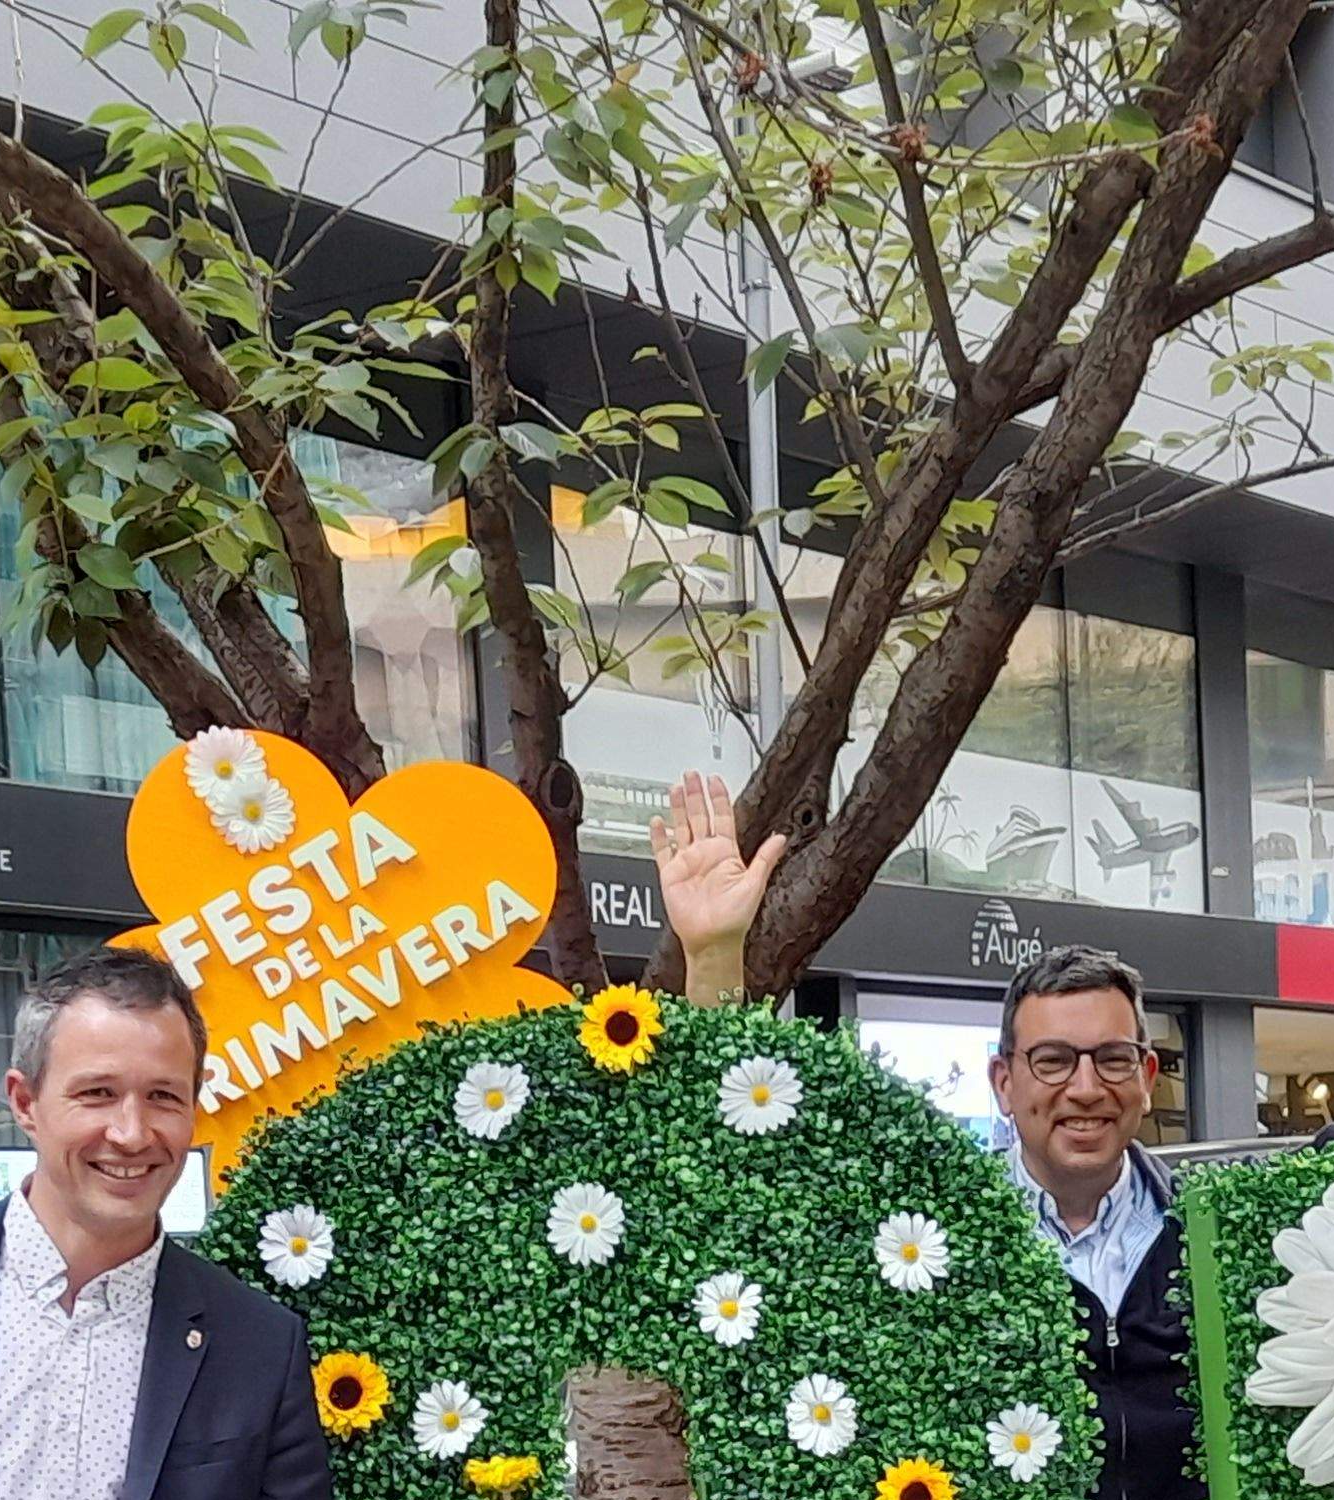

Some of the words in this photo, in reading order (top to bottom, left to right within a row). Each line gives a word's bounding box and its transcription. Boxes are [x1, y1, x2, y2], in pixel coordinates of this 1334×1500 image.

[156, 810, 419, 991] FESTA
[590, 881, 661, 929] REAL
[984, 923, 1042, 972] Augé
[196, 879, 542, 1115] RIMAVERA
[251, 937, 323, 999] DE
[317, 903, 388, 960] LA
